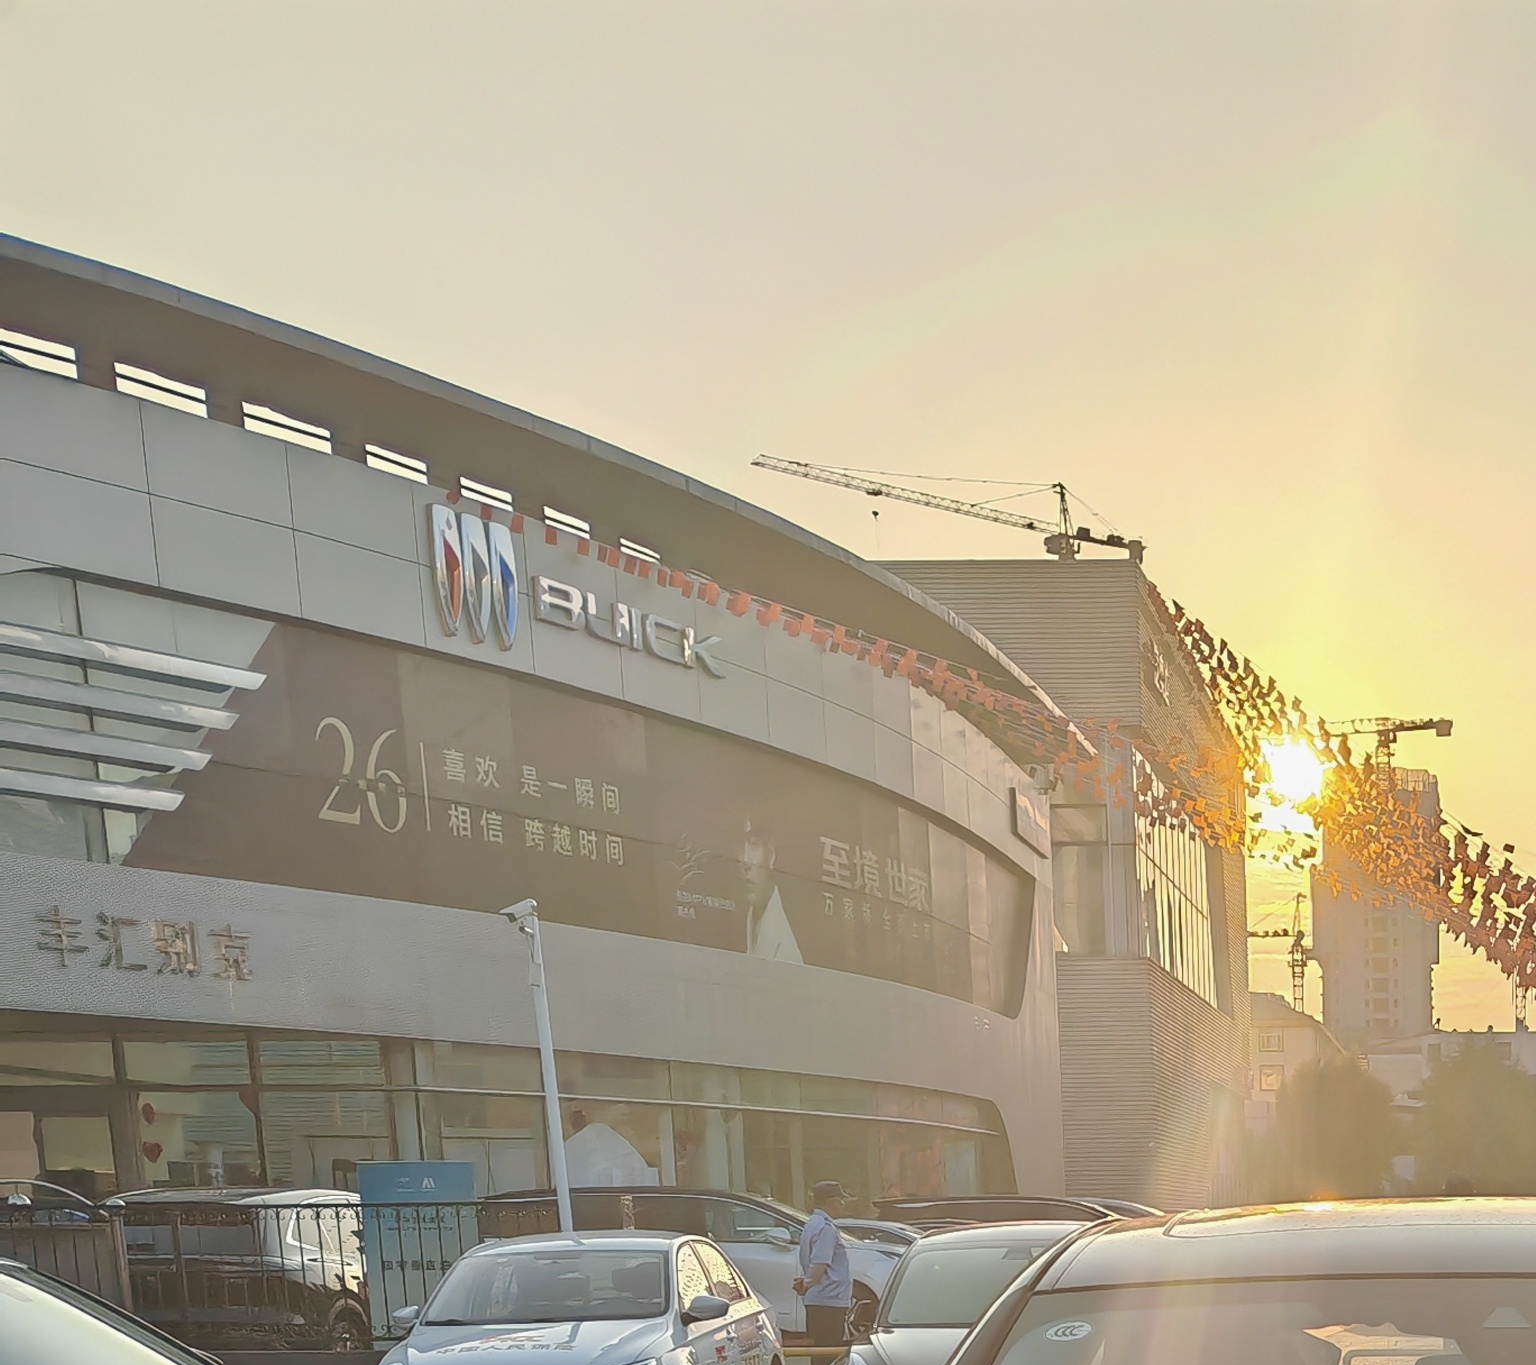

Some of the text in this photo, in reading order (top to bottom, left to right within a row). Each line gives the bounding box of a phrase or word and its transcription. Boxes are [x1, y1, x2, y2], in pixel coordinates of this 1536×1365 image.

[531, 575, 726, 679] BUICK
[315, 717, 407, 834] 26
[442, 748, 621, 815] 喜欢 是一瞬间
[448, 803, 625, 866] 相信 跨越时间
[820, 836, 932, 912] 至境世家
